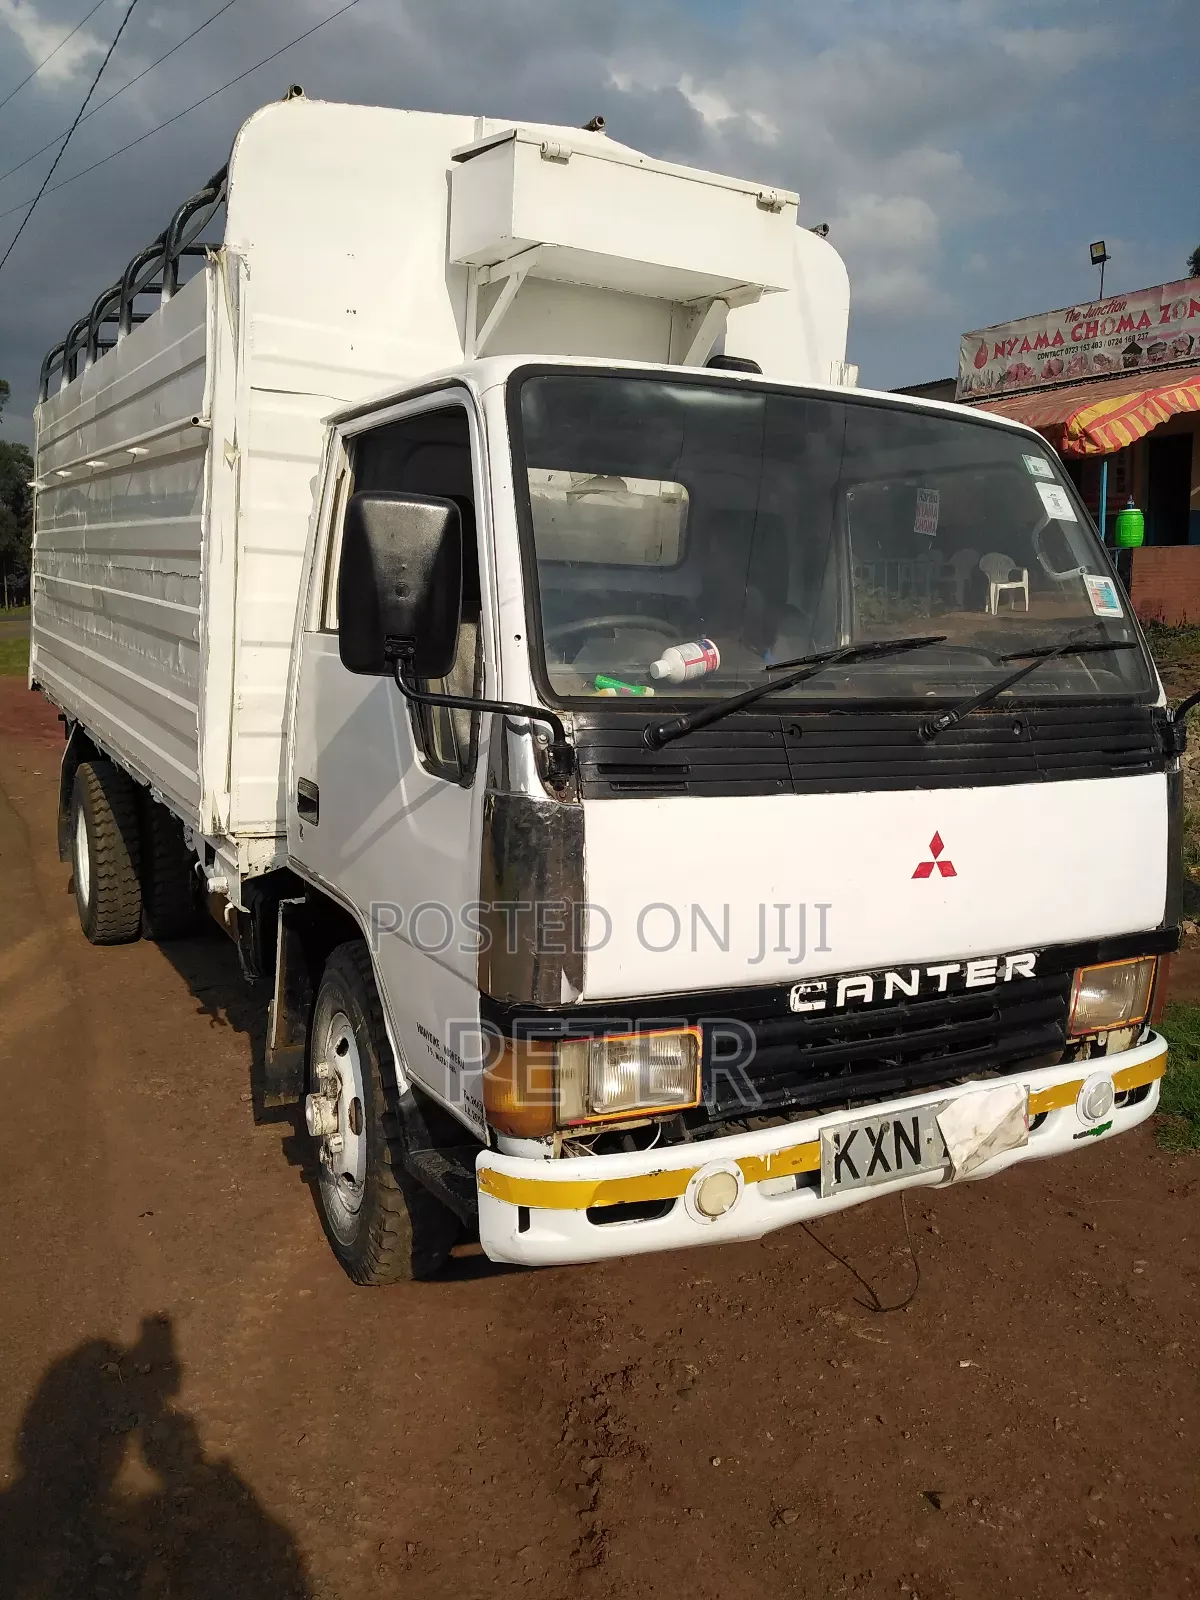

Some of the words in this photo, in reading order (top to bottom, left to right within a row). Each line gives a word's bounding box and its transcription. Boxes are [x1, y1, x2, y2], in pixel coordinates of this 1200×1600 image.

[1065, 307, 1081, 323] The
[1083, 300, 1127, 319] Junction
[993, 328, 1065, 360] NYAMA
[1071, 309, 1152, 342] CHOMA
[1037, 348, 1064, 360] CONTACT
[789, 952, 1037, 1012] CANTER
